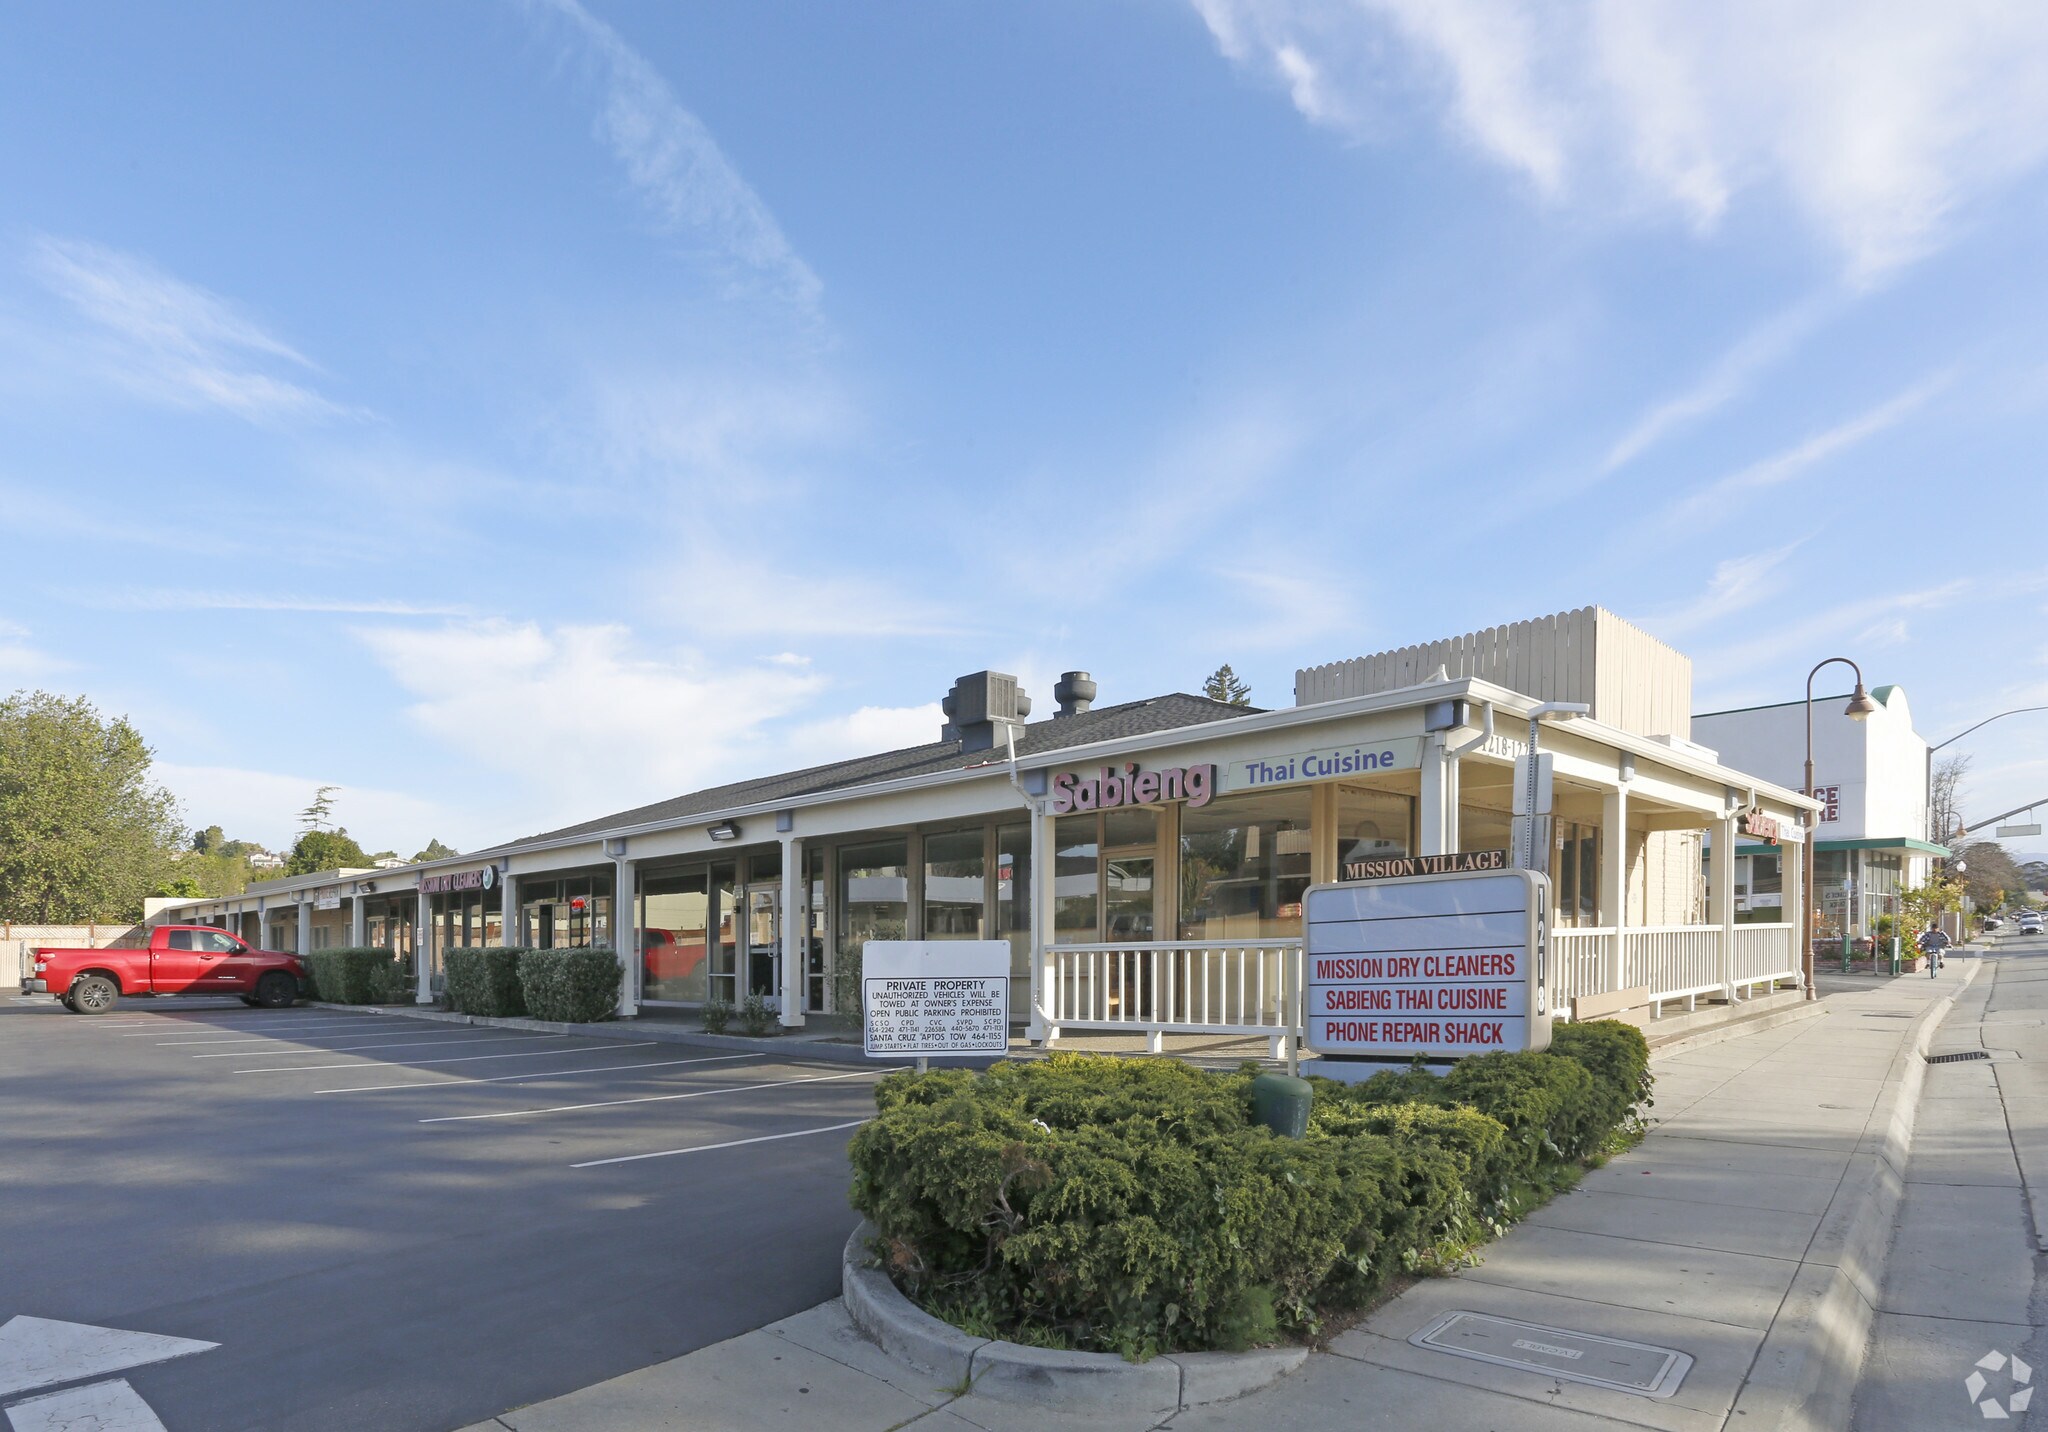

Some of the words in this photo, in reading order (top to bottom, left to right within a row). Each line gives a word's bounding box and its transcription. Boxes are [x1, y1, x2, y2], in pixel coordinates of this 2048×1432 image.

[1245, 758, 1295, 784] Thai
[1302, 749, 1394, 777] Cuisine
[1053, 762, 1214, 813] Sabieng
[1345, 859, 1415, 880] MISSION
[1420, 851, 1503, 874] VILLAGE
[1317, 958, 1383, 979] MISSION
[1387, 957, 1421, 978] DRY
[1424, 953, 1515, 977] CLEANERS
[872, 992, 929, 1000] UNAUTHORIZED
[933, 991, 965, 999] VEHICLES
[991, 990, 1000, 998] BE
[887, 981, 926, 991] PRIVATE
[934, 980, 986, 990] PROPERTY
[880, 1000, 906, 1008] TOWED
[911, 1000, 919, 1008] AT
[924, 1000, 957, 1008] OWNER'S
[962, 999, 993, 1007] EXPENSE
[1326, 990, 1391, 1010] SABIENG
[1395, 989, 1433, 1010] THAI
[1437, 988, 1507, 1010] CUISINE
[870, 1010, 890, 1018] OPEN
[923, 1009, 956, 1017] PARKING
[961, 1008, 1002, 1016] PROHIBITED
[870, 1034, 893, 1042] SANTA
[898, 1034, 916, 1042] CRUZ
[971, 1032, 1002, 1040] 464-1155
[1326, 1022, 1378, 1042] PHONE
[1382, 1022, 1440, 1043] REPAIR
[1444, 1022, 1504, 1044] SHACK
